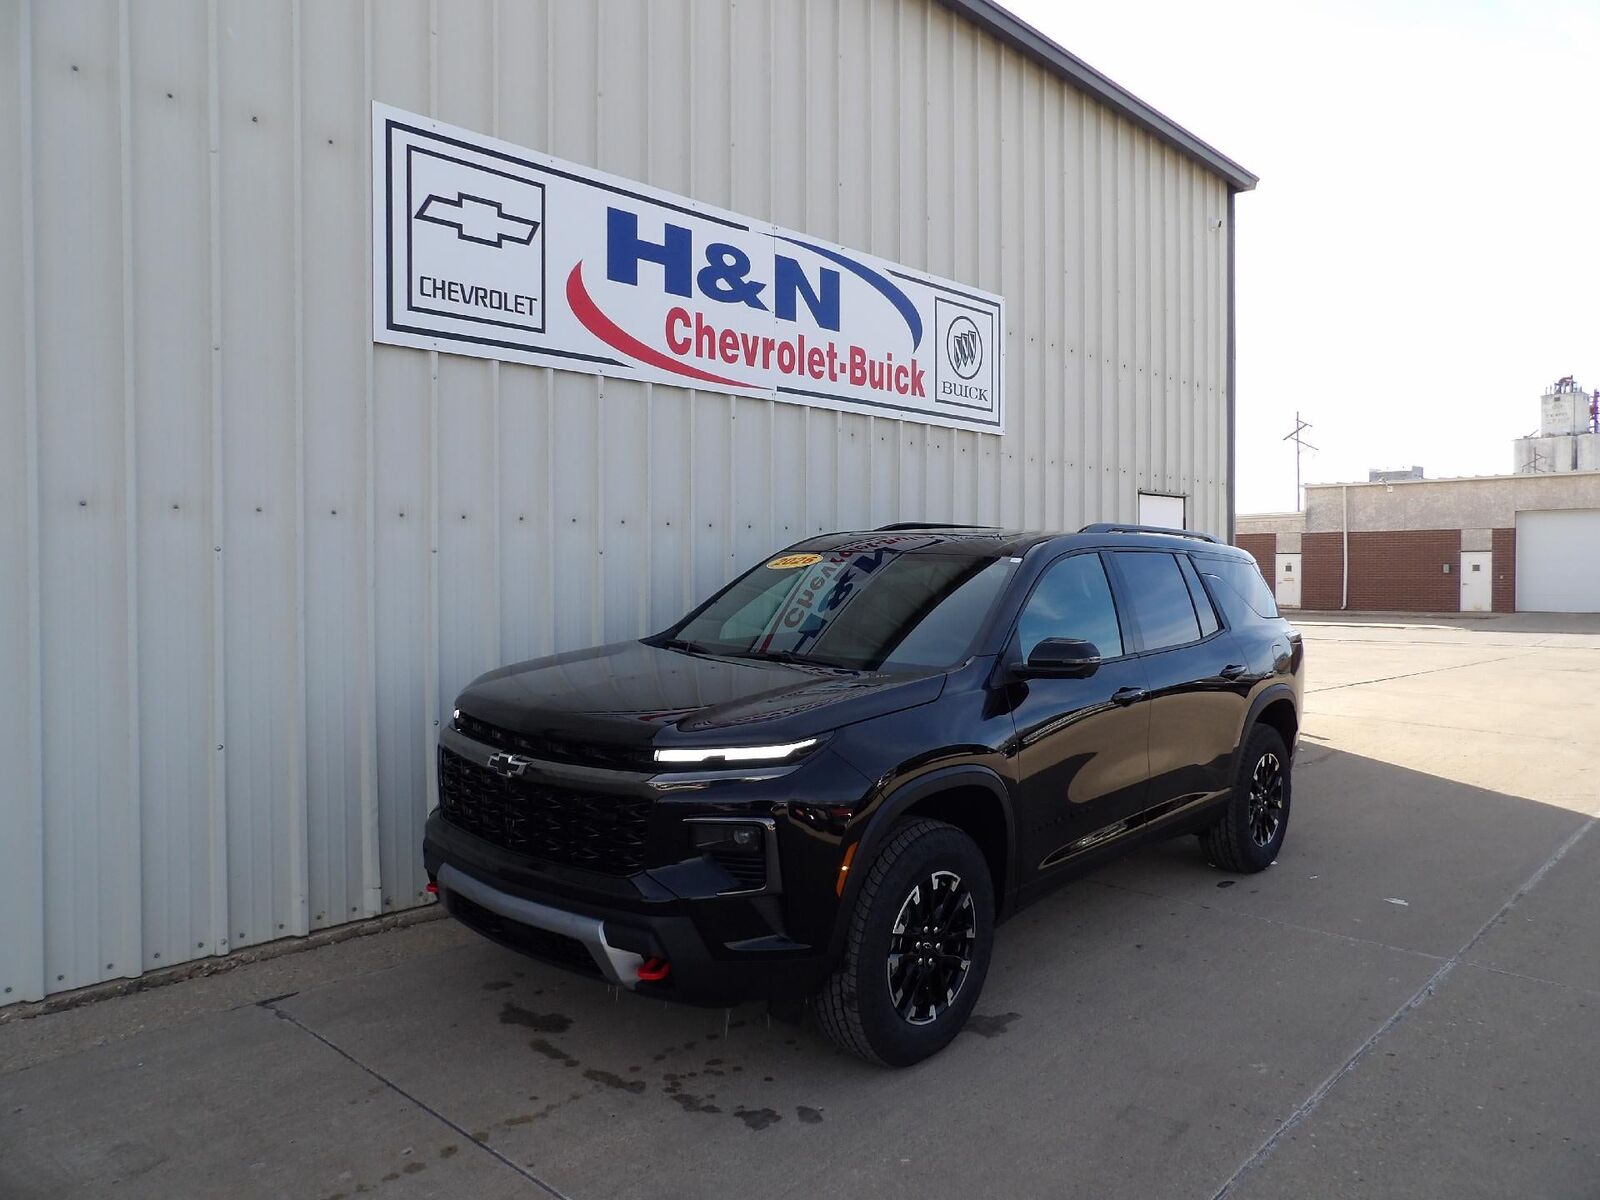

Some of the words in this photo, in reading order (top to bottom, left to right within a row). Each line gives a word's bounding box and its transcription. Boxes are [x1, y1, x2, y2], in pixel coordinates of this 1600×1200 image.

[419, 275, 538, 318] CHEVROLET
[607, 206, 840, 332] H&N
[665, 306, 926, 398] Chevrolet-Buick
[942, 381, 989, 402] BUICK
